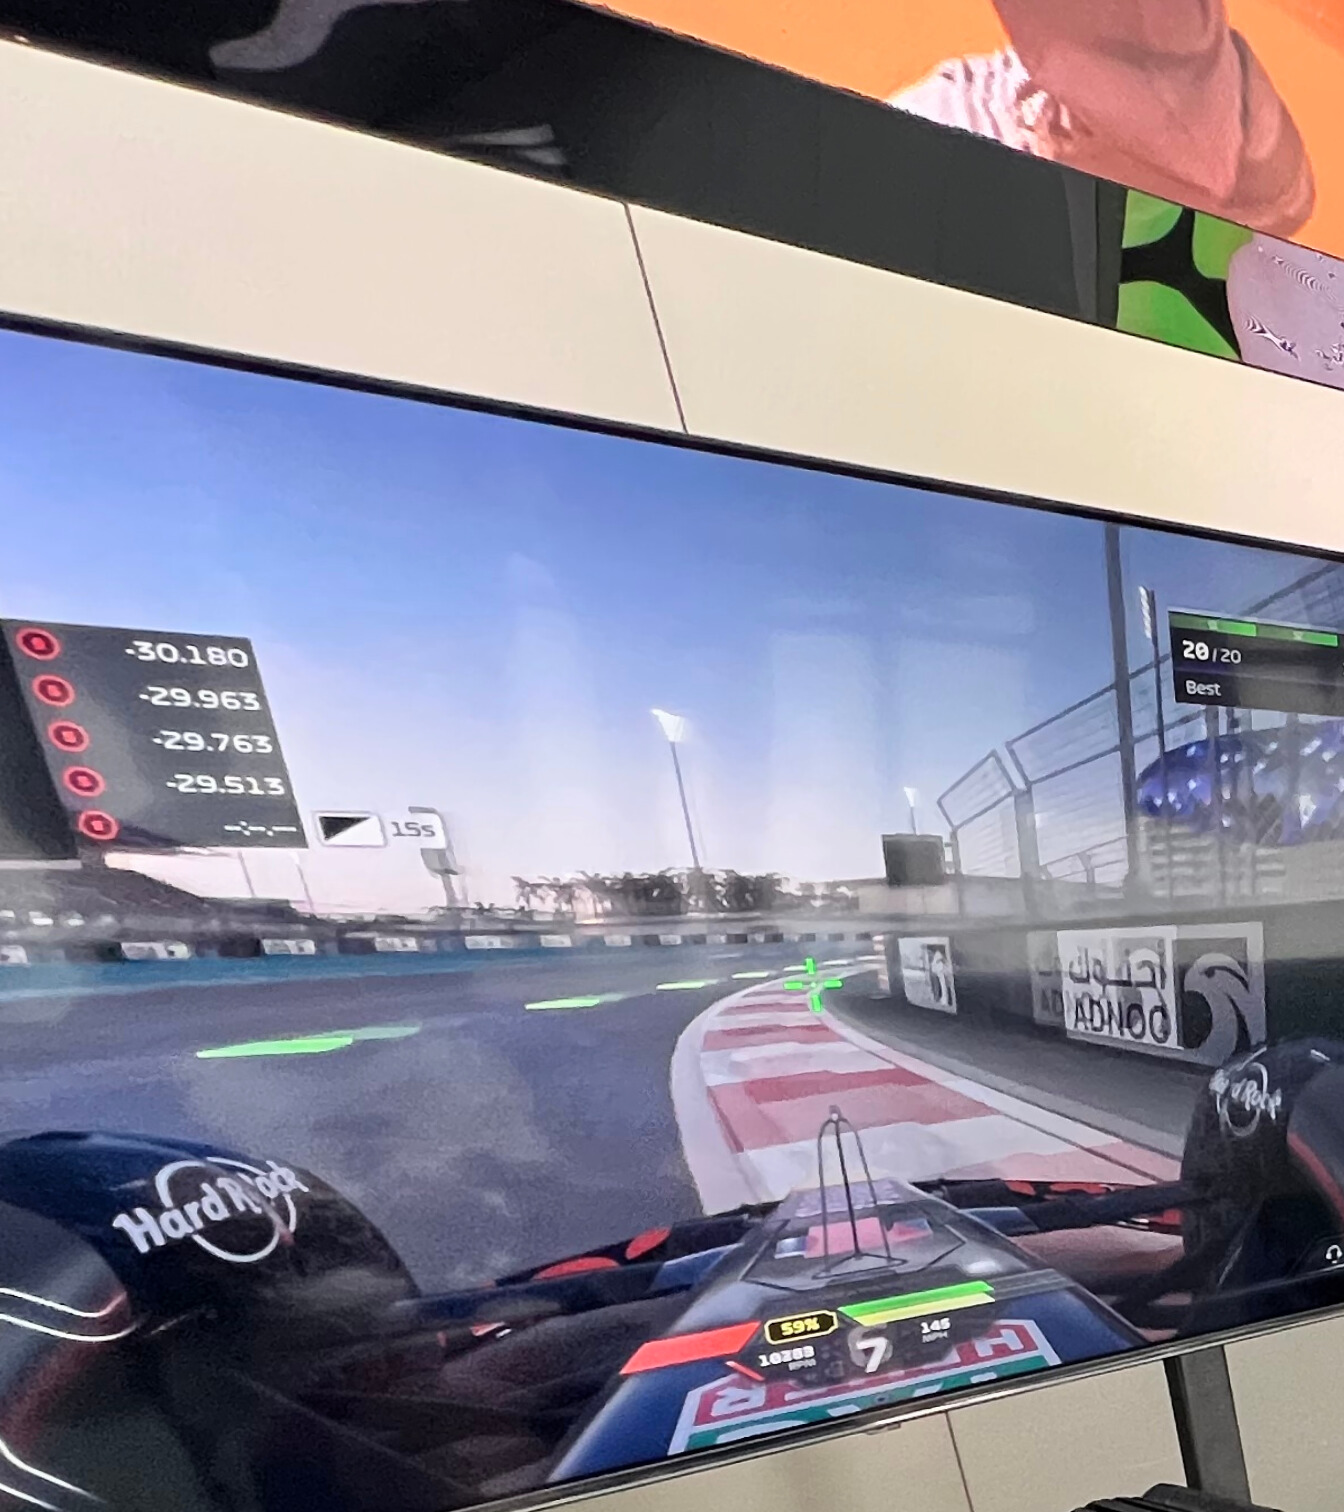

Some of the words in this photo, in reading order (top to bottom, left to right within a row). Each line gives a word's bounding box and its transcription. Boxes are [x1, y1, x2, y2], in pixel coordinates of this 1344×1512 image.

[125, 640, 250, 669] -30.180
[139, 685, 262, 711] -29.963
[1185, 680, 1222, 697] Best
[152, 729, 274, 754] -29.763
[166, 773, 286, 797] -29.513
[390, 820, 436, 839] 15s
[112, 1182, 231, 1254] Hard
